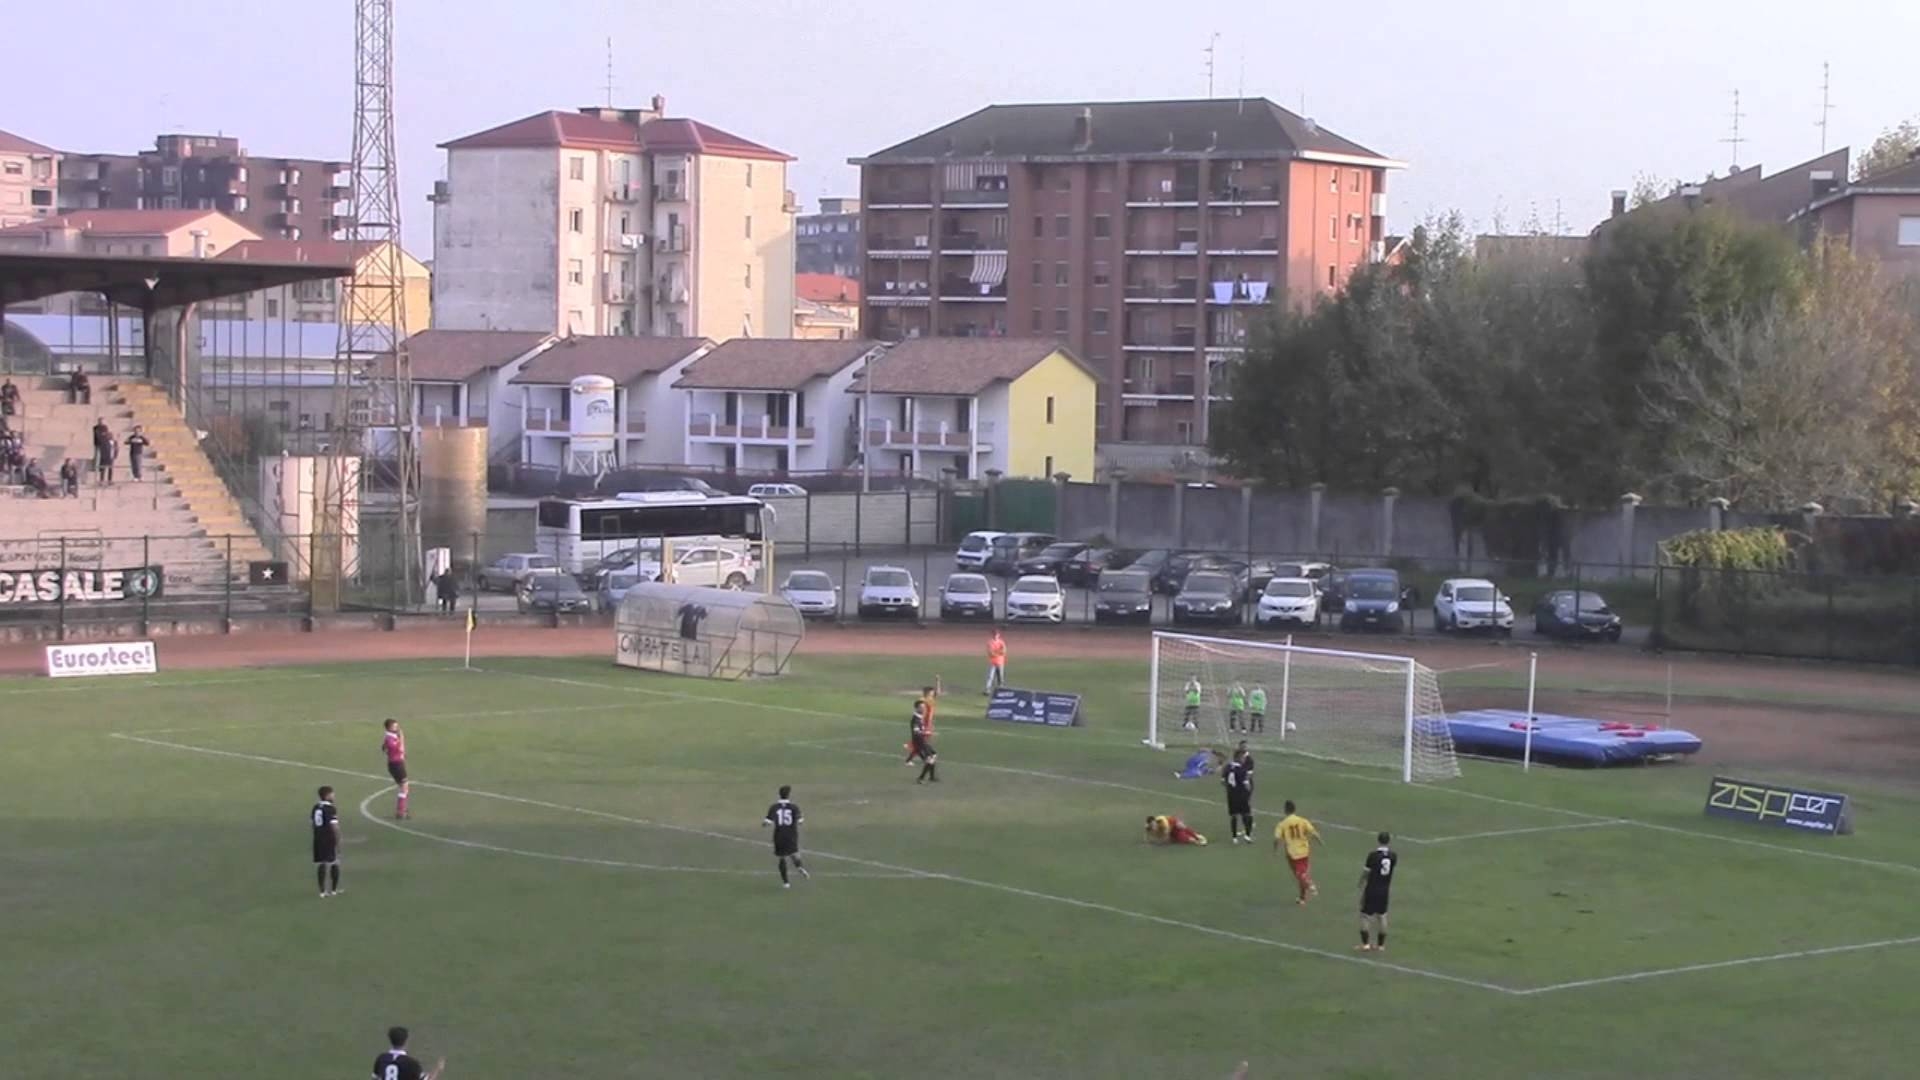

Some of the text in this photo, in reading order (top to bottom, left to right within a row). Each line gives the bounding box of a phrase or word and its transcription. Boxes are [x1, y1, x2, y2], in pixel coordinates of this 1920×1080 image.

[0, 571, 124, 602] CASALE
[776, 809, 793, 826] 15
[1380, 858, 1391, 875] 3
